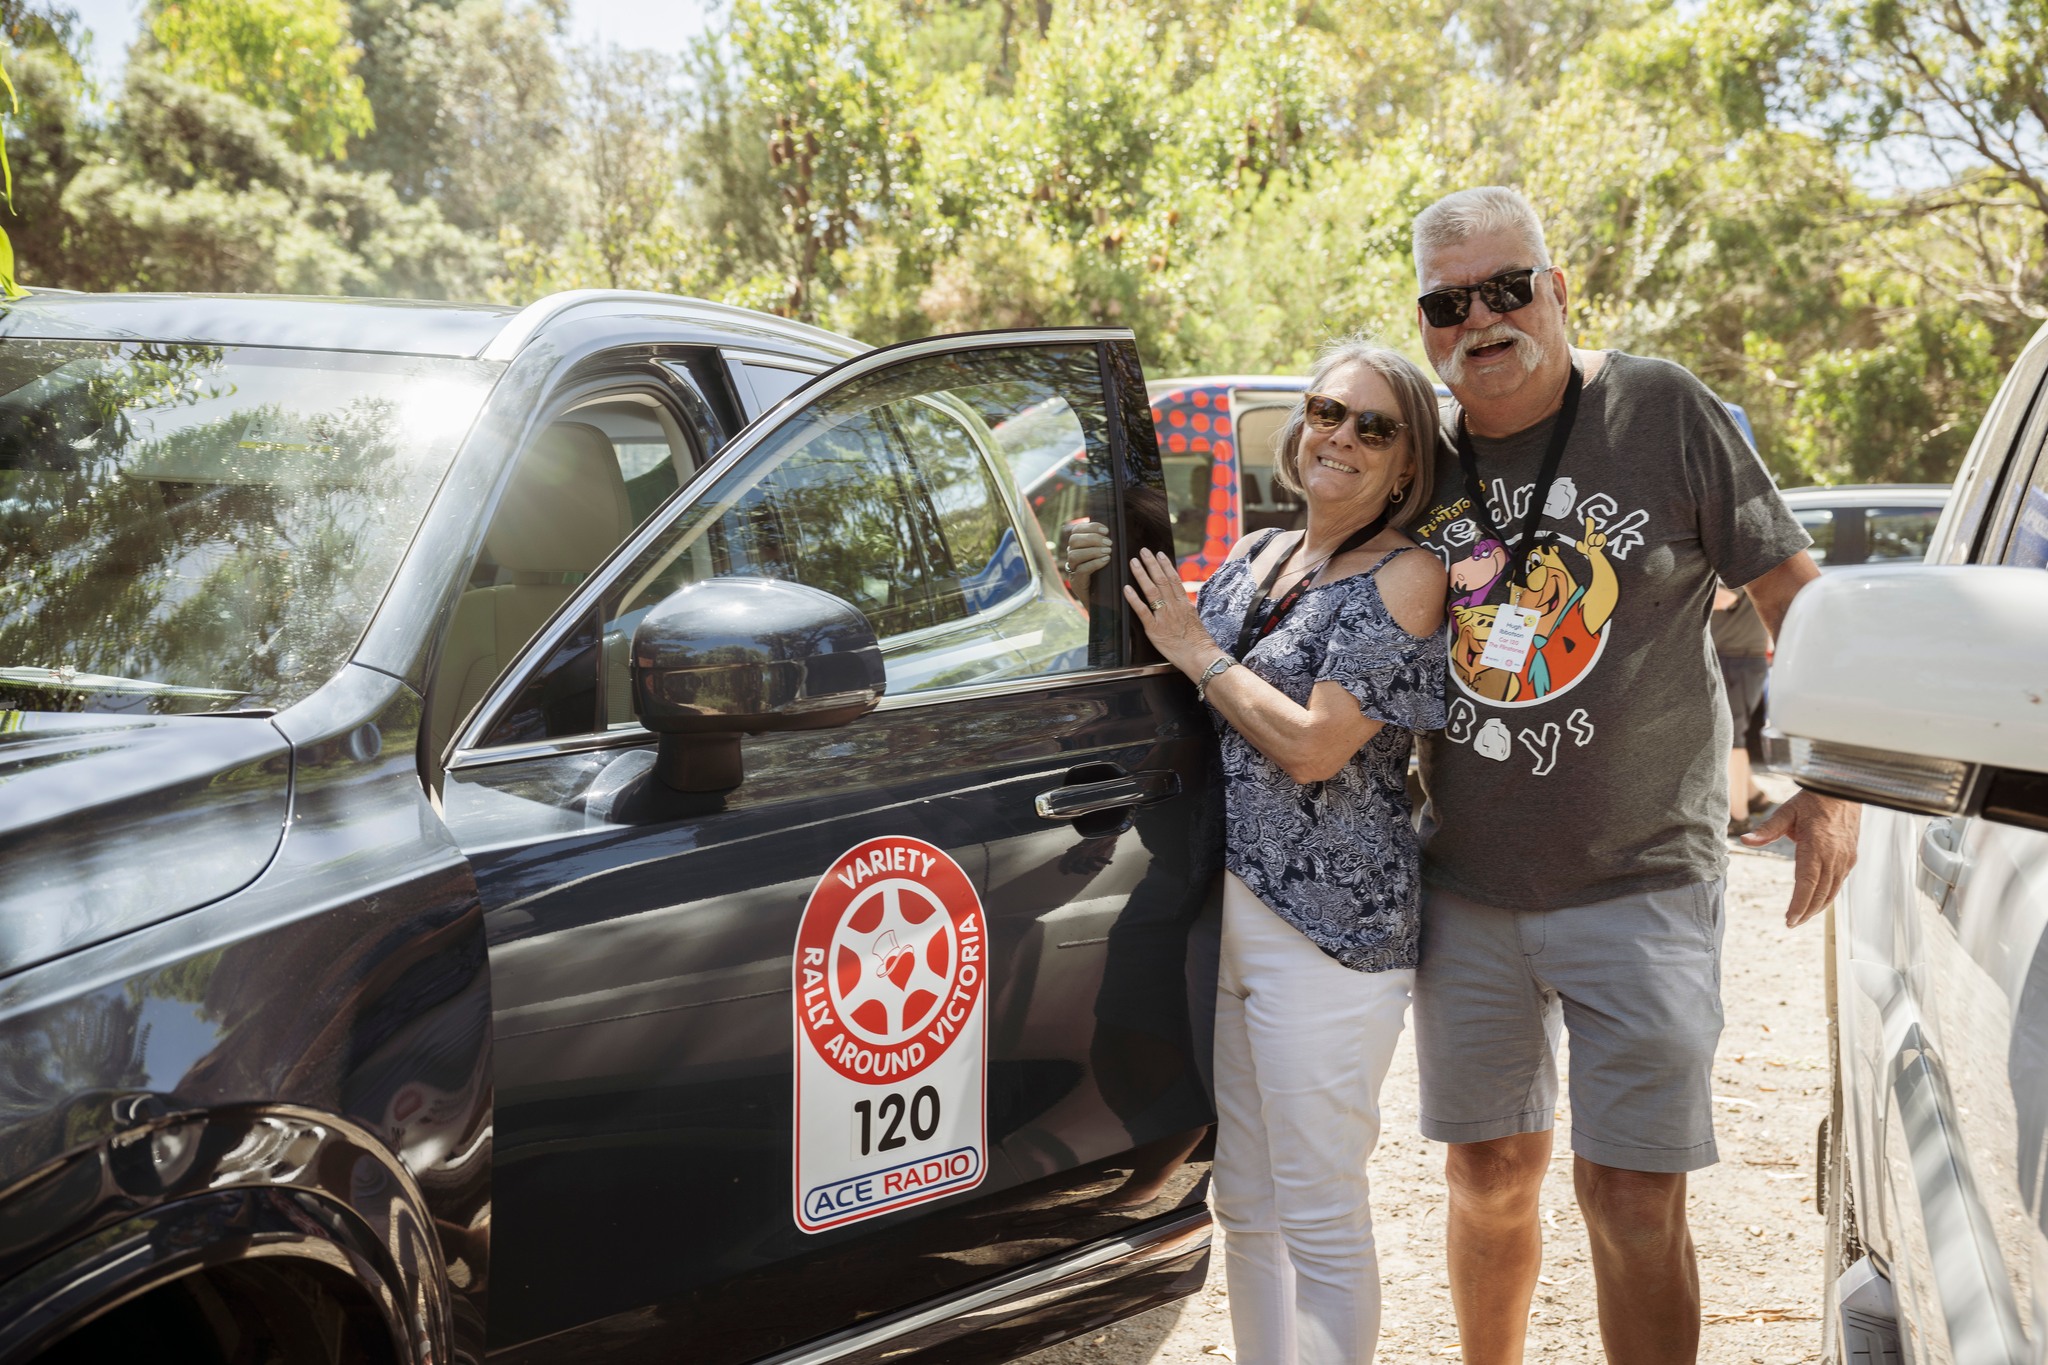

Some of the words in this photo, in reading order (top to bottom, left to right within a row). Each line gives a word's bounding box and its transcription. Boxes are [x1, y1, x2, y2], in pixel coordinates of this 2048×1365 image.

[837, 847, 936, 890] VARIETY
[802, 947, 834, 1030] RALLY
[823, 1033, 926, 1077] AROUND
[927, 913, 980, 1045] VICTORIA
[854, 1085, 941, 1156] 120
[814, 1180, 873, 1214] ACE
[883, 1154, 970, 1195] RADIO
